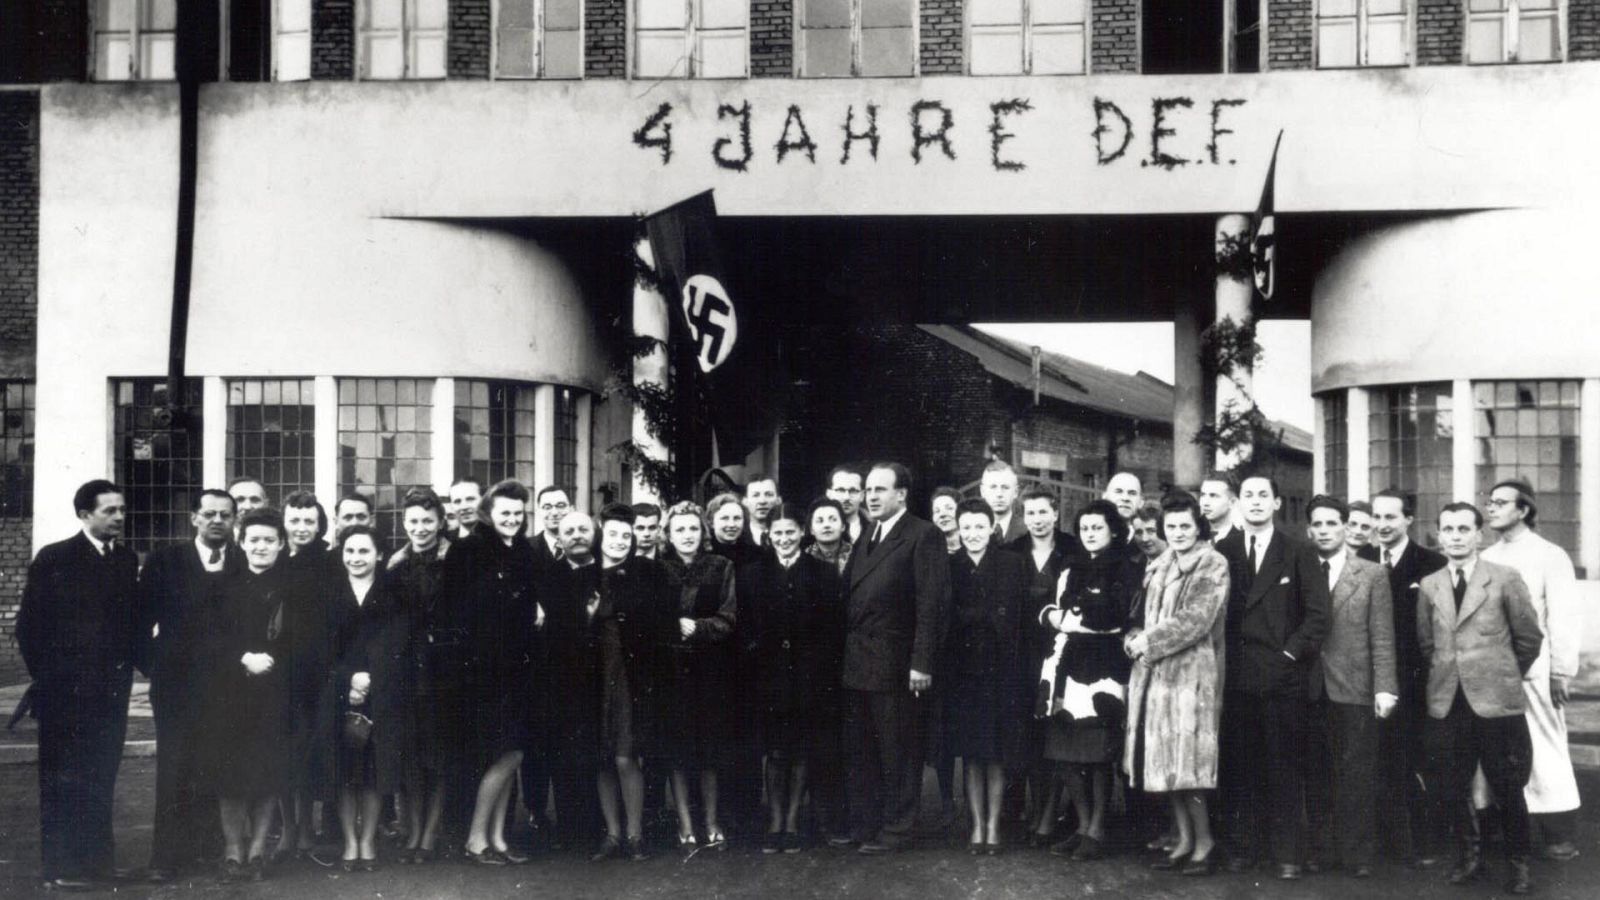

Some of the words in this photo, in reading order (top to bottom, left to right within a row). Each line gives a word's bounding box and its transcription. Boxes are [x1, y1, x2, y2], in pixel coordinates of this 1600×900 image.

[633, 101, 673, 165] 4
[712, 98, 1034, 172] JAHRE
[1093, 97, 1247, 170] D.E.F.
